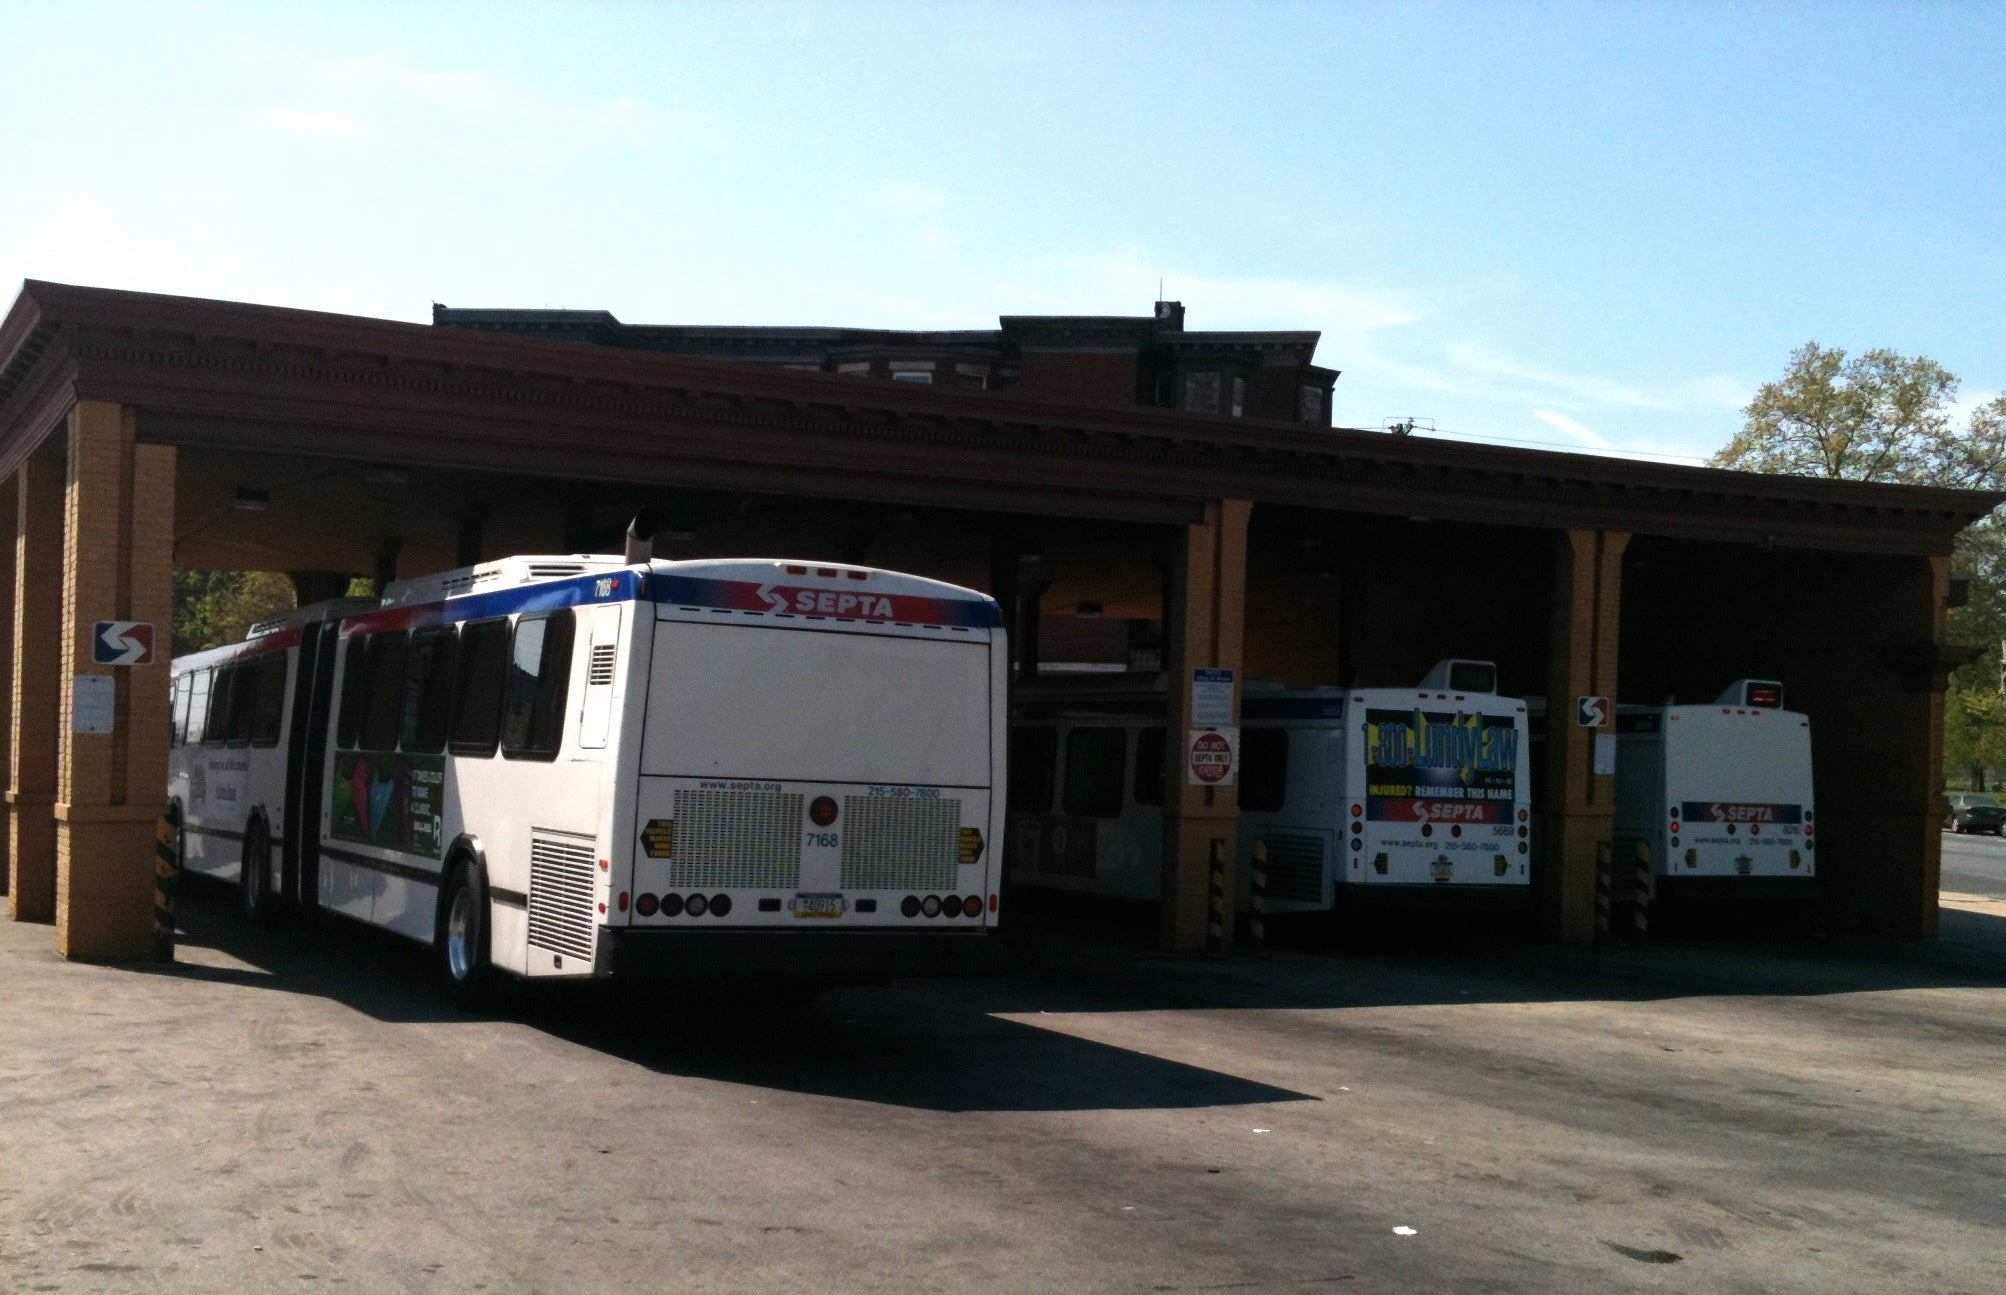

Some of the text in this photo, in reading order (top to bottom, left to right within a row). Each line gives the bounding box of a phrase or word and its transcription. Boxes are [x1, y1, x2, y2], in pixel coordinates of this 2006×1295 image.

[796, 590, 894, 617] SEPTA
[1194, 753, 1212, 762] SEPTA
[700, 781, 782, 792] www.septa.org
[868, 786, 940, 798] 215-580-7800
[1369, 784, 1512, 801] INJURED? REMEMBER THIS NAME
[1431, 803, 1484, 820] SEPTA
[1728, 806, 1774, 821] SEPTA
[806, 833, 839, 848] 7168
[1381, 839, 1438, 850] www.septa.org
